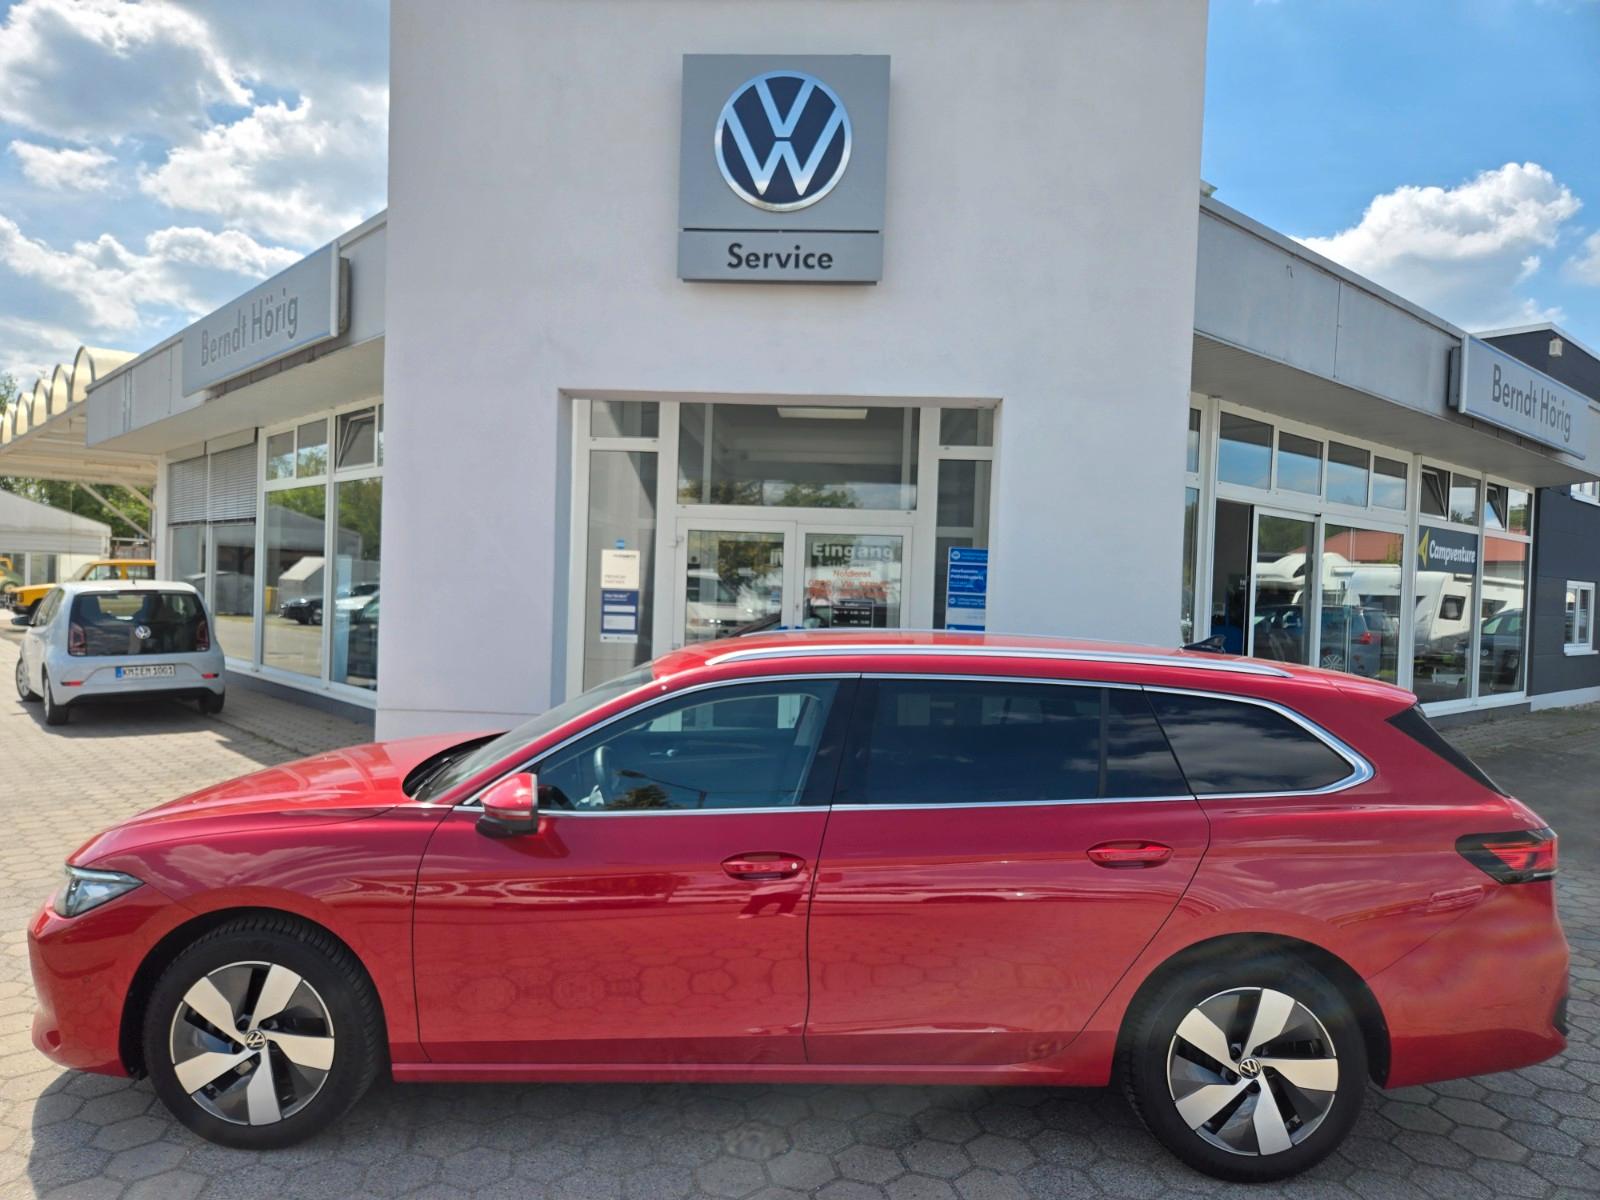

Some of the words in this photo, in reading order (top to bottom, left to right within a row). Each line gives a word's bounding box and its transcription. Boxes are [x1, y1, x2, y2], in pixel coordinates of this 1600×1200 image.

[714, 70, 852, 212] VW
[727, 242, 833, 270] Service
[201, 308, 247, 367] Berndt
[251, 287, 299, 340] Hörig
[1492, 363, 1537, 419] Berndt
[1540, 387, 1571, 443] Hörig
[812, 542, 895, 561] Eingang
[1429, 539, 1476, 566] Campventure
